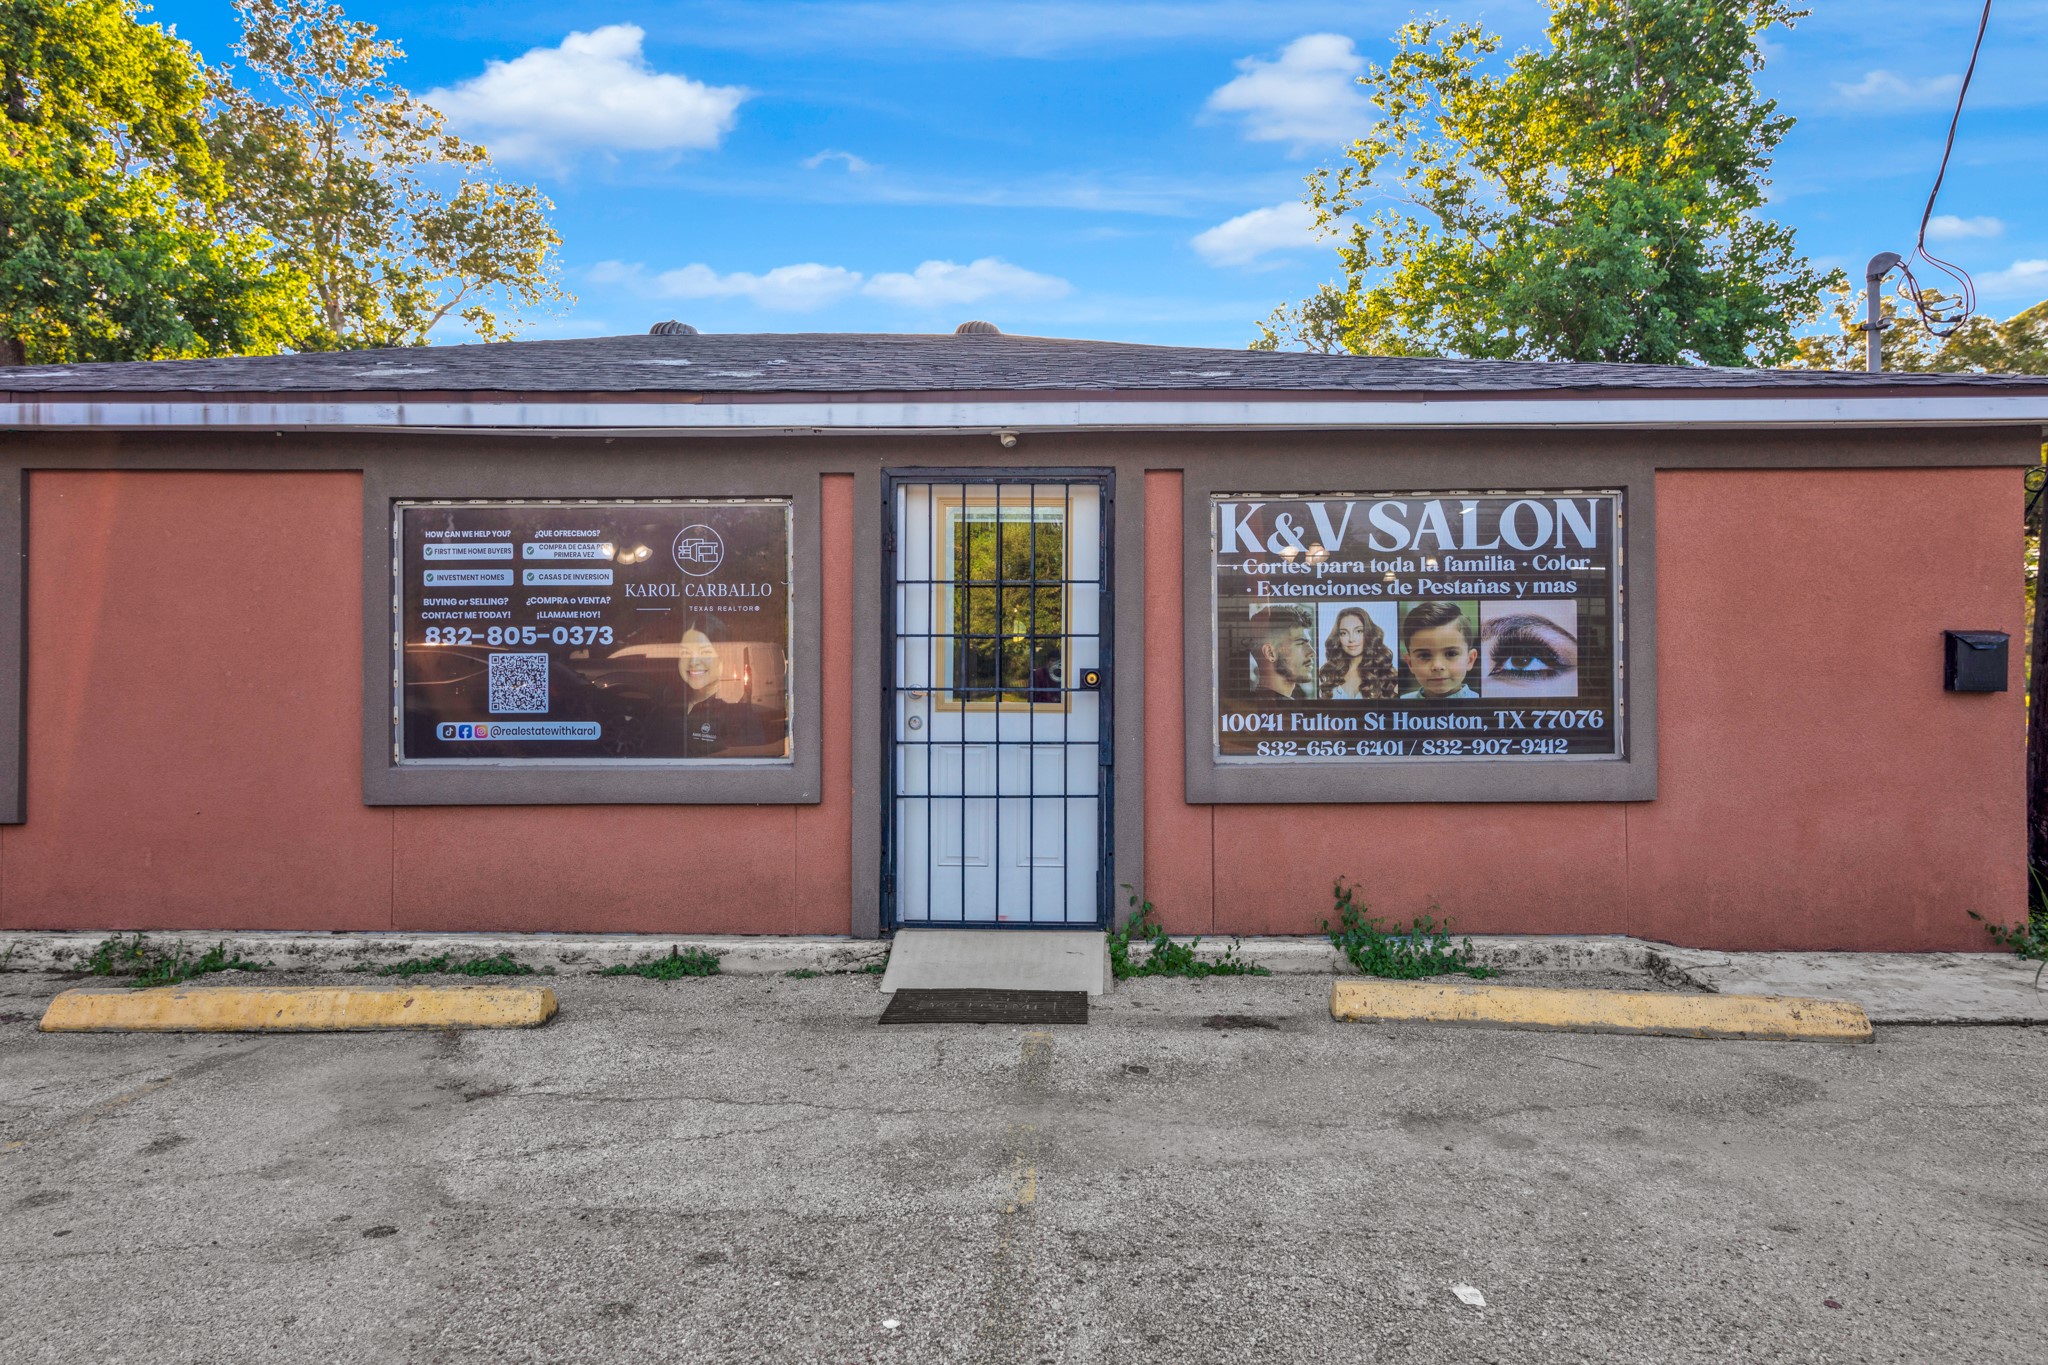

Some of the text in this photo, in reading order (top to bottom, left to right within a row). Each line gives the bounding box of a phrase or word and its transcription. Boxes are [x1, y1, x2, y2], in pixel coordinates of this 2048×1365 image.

[1368, 498, 1599, 552] SALON
[492, 530, 511, 538] YOU?
[534, 530, 552, 538] ¿QUE
[1242, 554, 1591, 578] Cortes para toda la familia Color
[624, 583, 772, 597] KAROL CARBALLO
[1257, 576, 1578, 599] Extenciones de Pestañas y mas
[470, 598, 508, 606] SELLING?
[526, 596, 569, 606] ¿COMPRA
[578, 596, 611, 604] VENTA?
[536, 610, 600, 620] ¡LLAMAME HOY!
[425, 626, 614, 646] 832-805-0373
[1221, 710, 1604, 732] 10041 Fulton St Houston, TX 77076
[490, 726, 596, 738] @realestatewithkarol
[1256, 740, 1404, 756] 832-656-6401
[1422, 738, 1568, 754] 832-907-9412
